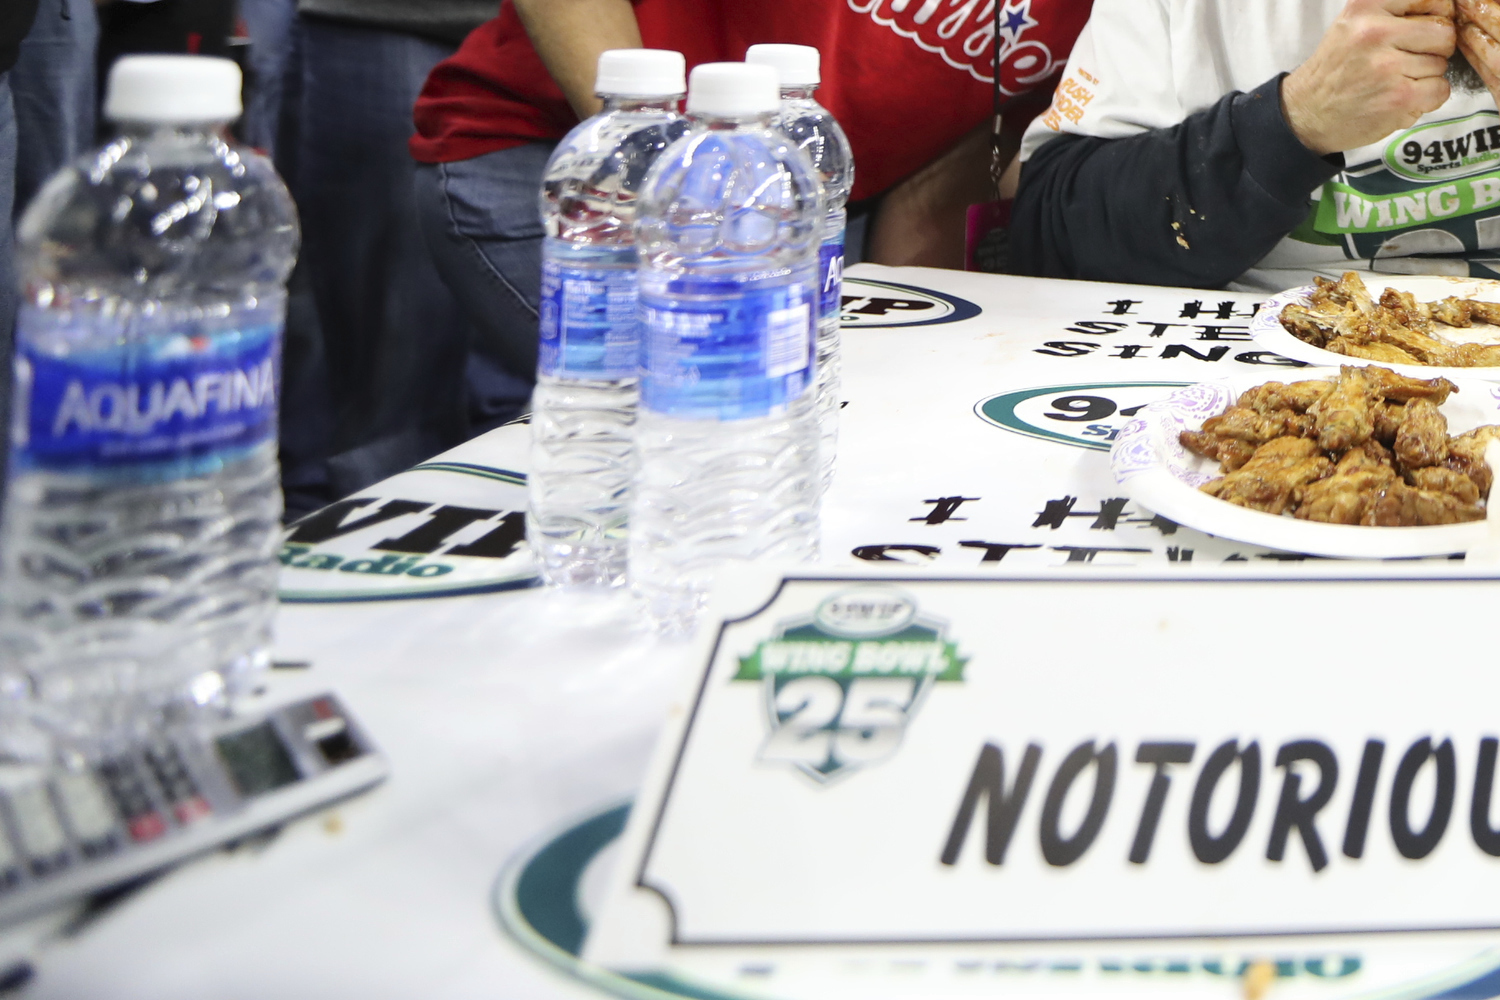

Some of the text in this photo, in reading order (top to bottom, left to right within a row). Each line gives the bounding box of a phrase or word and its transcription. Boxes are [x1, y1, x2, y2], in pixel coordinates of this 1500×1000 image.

[1334, 186, 1460, 228] WING
[1064, 321, 1253, 341] STE
[1032, 341, 1309, 367] SING
[52, 357, 276, 438] AQUAFINA
[760, 677, 915, 769] 25
